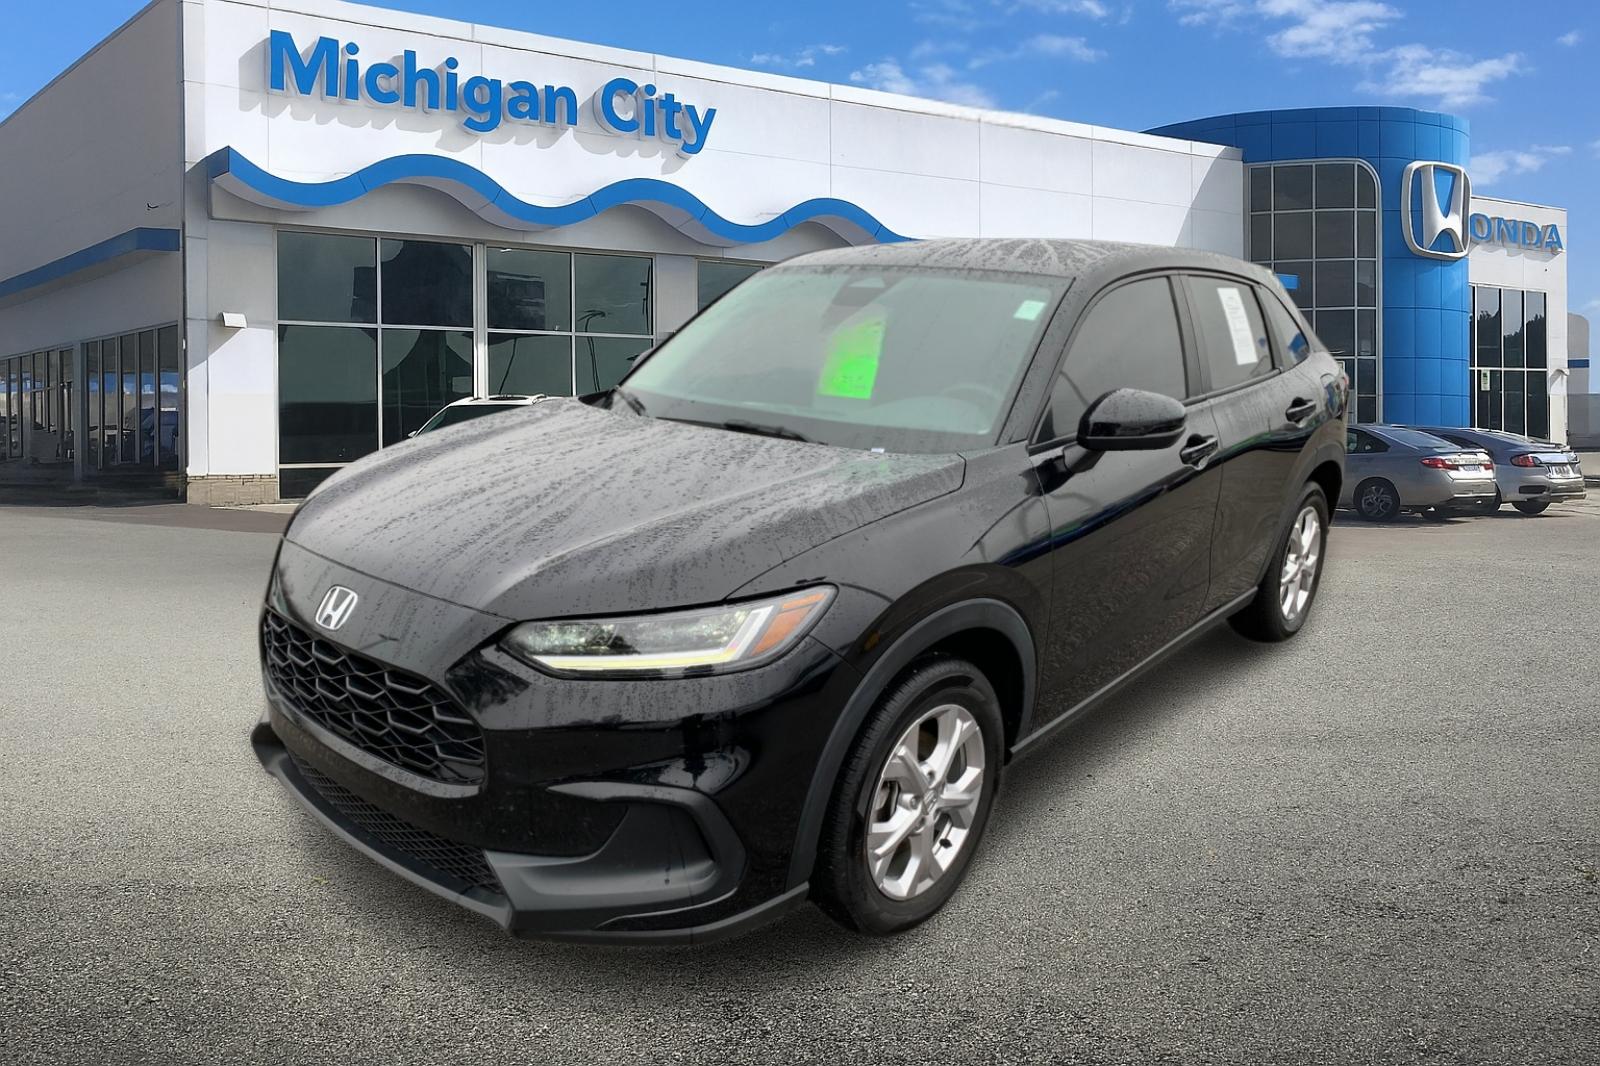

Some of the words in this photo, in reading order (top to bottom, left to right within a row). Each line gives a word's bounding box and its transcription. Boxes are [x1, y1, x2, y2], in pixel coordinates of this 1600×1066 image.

[270, 30, 578, 133] Michigan
[600, 77, 717, 155] City
[1469, 212, 1565, 250] ONDA
